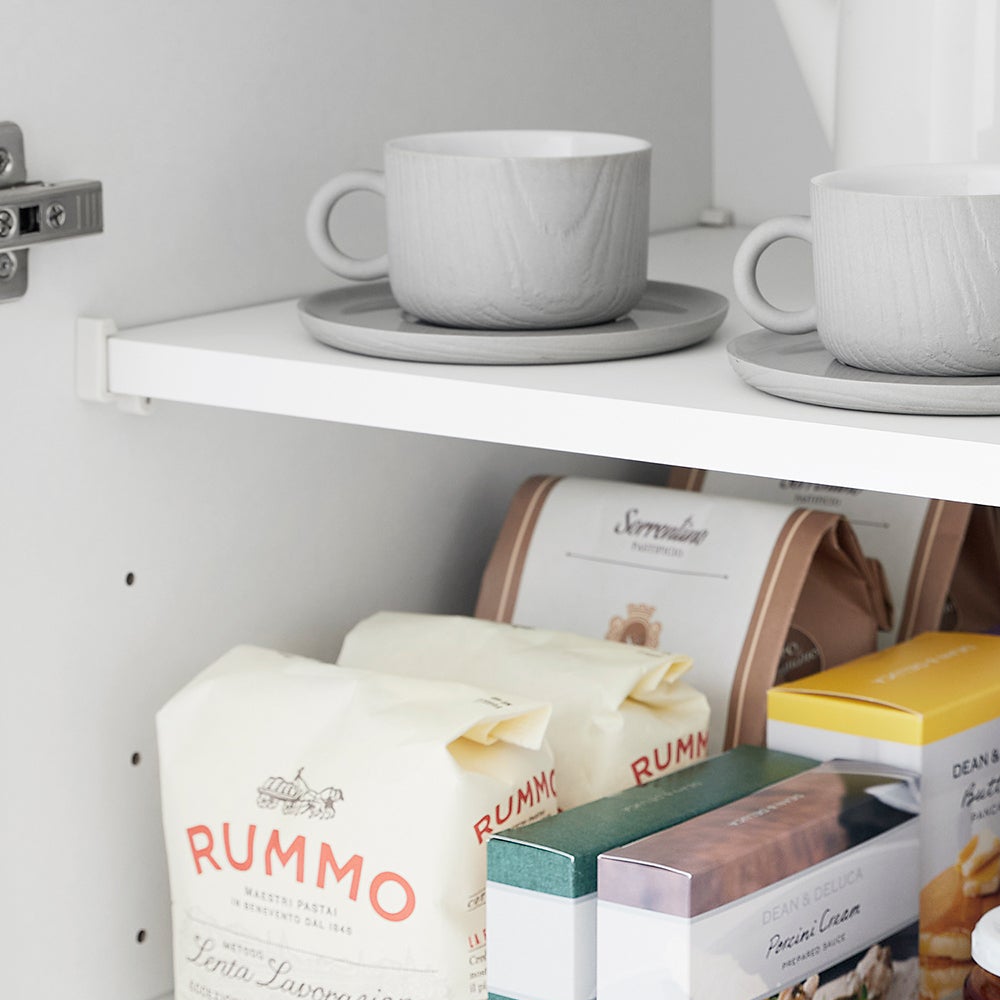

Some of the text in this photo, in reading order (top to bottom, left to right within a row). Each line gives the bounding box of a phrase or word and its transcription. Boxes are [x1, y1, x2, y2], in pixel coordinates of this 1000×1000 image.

[952, 752, 989, 779] DEAN
[991, 748, 1000, 764] &
[186, 822, 416, 922] RUMMO
[244, 886, 338, 917] MAESTRI PASTAI
[762, 868, 863, 925] DEAN & DELUCA
[244, 901, 301, 925] BENEVENTO
[304, 918, 325, 930] DAL
[187, 934, 255, 983] Lenta
[782, 932, 846, 969] PREPARED SAUCE
